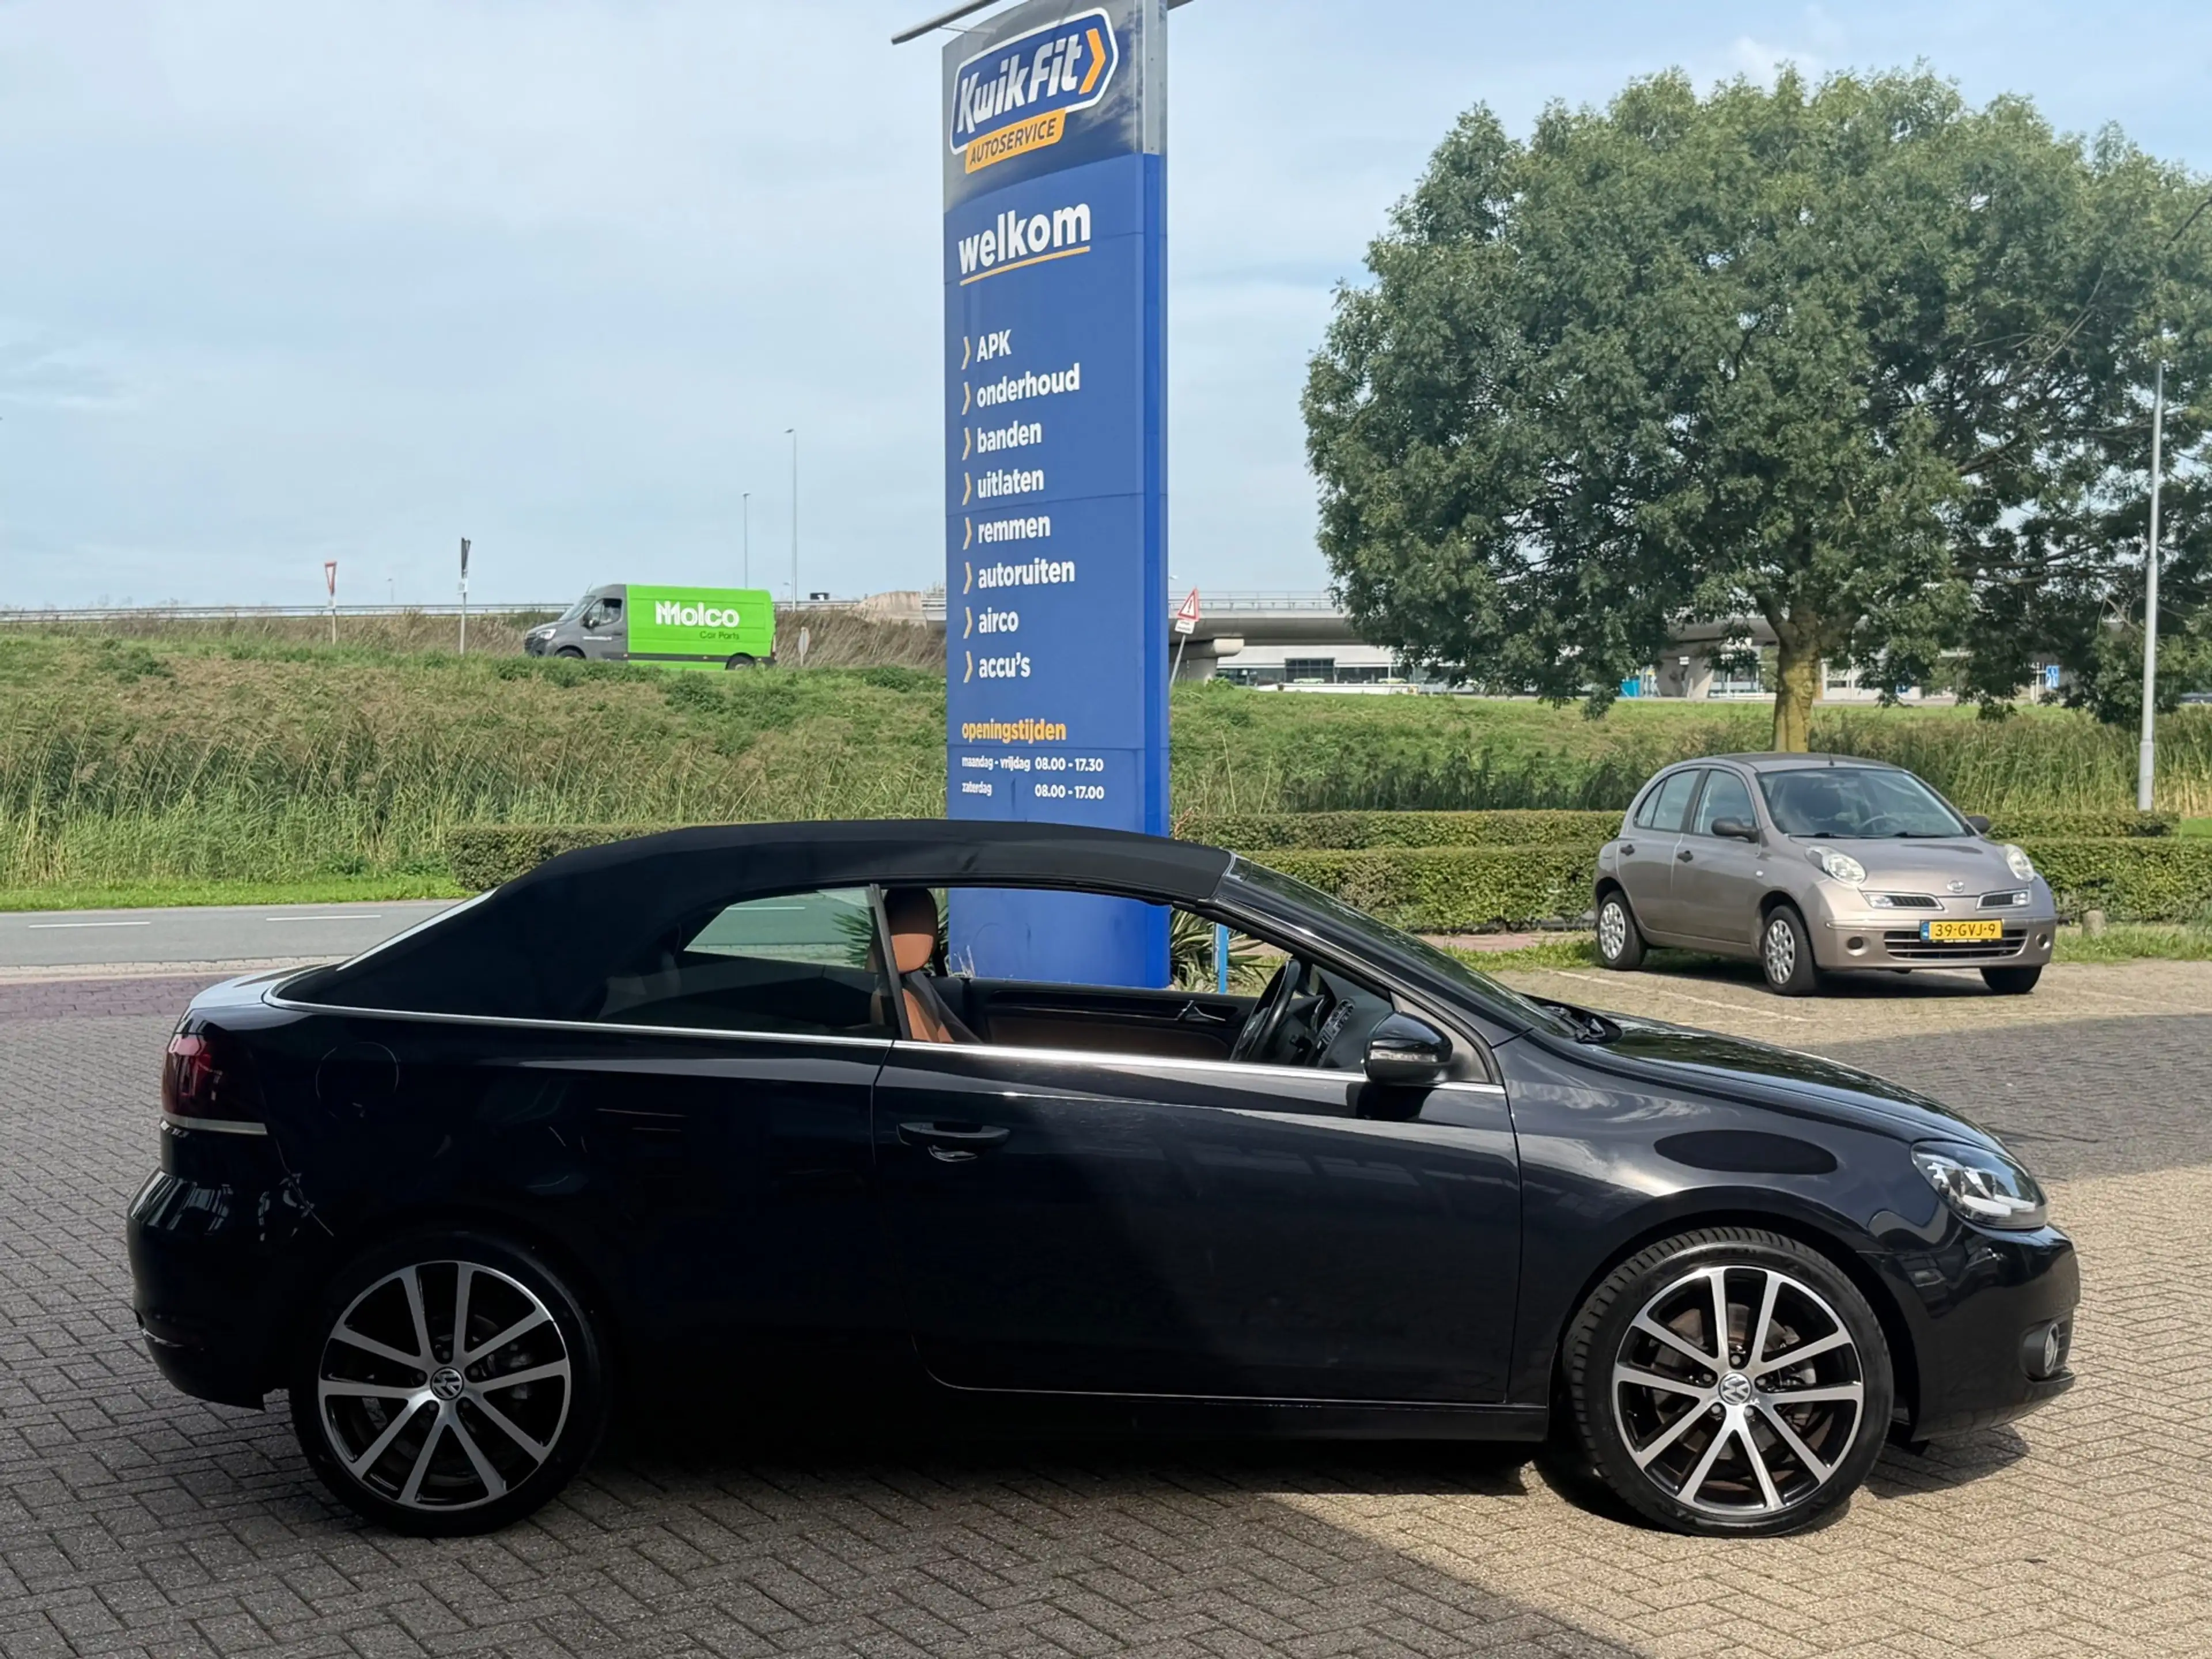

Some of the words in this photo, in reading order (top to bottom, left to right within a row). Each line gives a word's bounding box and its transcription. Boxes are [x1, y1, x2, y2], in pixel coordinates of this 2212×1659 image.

[969, 116, 1056, 166] AUTOSERVICE
[958, 203, 1090, 274] welkom
[976, 329, 1012, 362] APK
[977, 362, 1080, 407] onderhoud
[978, 420, 1041, 453] banden
[978, 469, 1044, 499] uitlaten
[978, 516, 1050, 543] remmen
[978, 557, 1075, 589] autoruiten
[655, 600, 740, 627] Molco
[979, 607, 1019, 633] airco
[699, 631, 716, 639] Car
[718, 631, 740, 640] Parts
[979, 652, 1031, 678] accu's
[962, 718, 1066, 744] openingstijden
[962, 755, 993, 771] maandag
[1000, 756, 1031, 772] vrijdag
[1035, 757, 1066, 771] 08.00
[1075, 758, 1104, 772] 17.30
[962, 781, 992, 796] zaterdag
[1035, 784, 1066, 798] 08.00
[1075, 786, 1104, 800] 17.00
[1936, 923, 1995, 937] 39-GVJ-9
